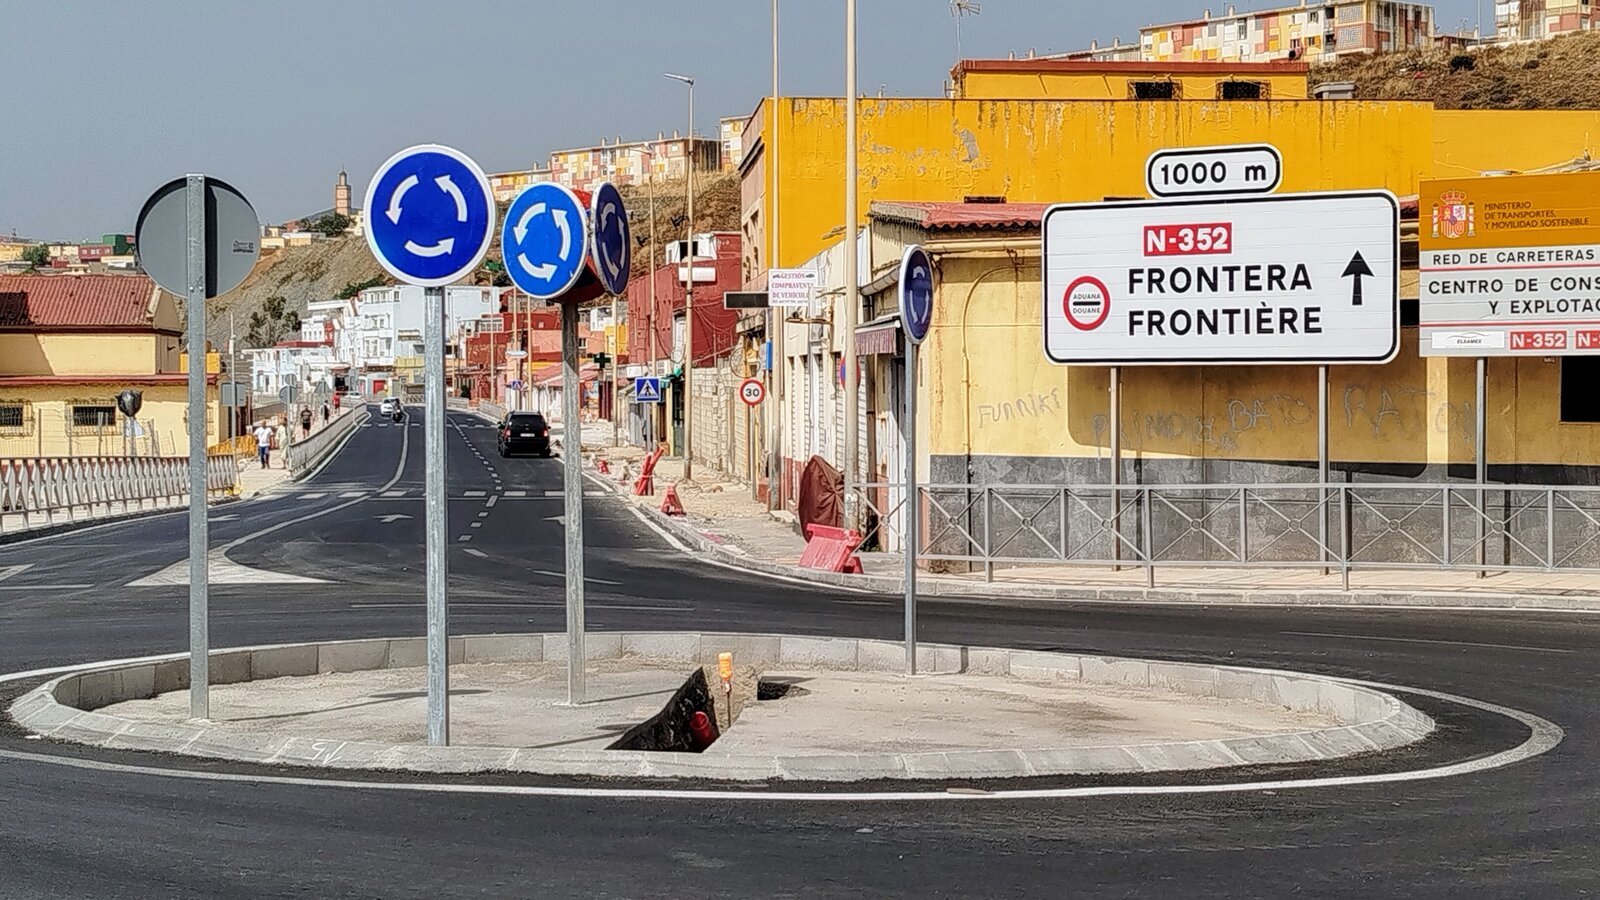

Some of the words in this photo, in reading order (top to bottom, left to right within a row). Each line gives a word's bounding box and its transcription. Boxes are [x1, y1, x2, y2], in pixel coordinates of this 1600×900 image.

[1161, 161, 1227, 185] 1000
[1245, 164, 1266, 181] m
[1484, 201, 1532, 210] MINISTERIO
[1484, 212, 1495, 220] DE
[1491, 220, 1538, 229] MOVILIDAD
[1540, 217, 1590, 227] SOSTENIBLE
[1146, 226, 1229, 252] N-352
[1433, 254, 1461, 265] RED
[1470, 253, 1488, 264] DE
[1496, 249, 1595, 263] CARRETERAS
[1129, 263, 1313, 294] FRONTERA
[1428, 279, 1503, 294] CENTRO
[1515, 278, 1539, 292] DE
[772, 291, 779, 299] DE
[1488, 301, 1499, 314] Y
[1129, 301, 1323, 336] FRONTIÈRE
[1512, 332, 1566, 347] N-352
[1578, 332, 1600, 347] N-
[745, 388, 760, 397] 30
